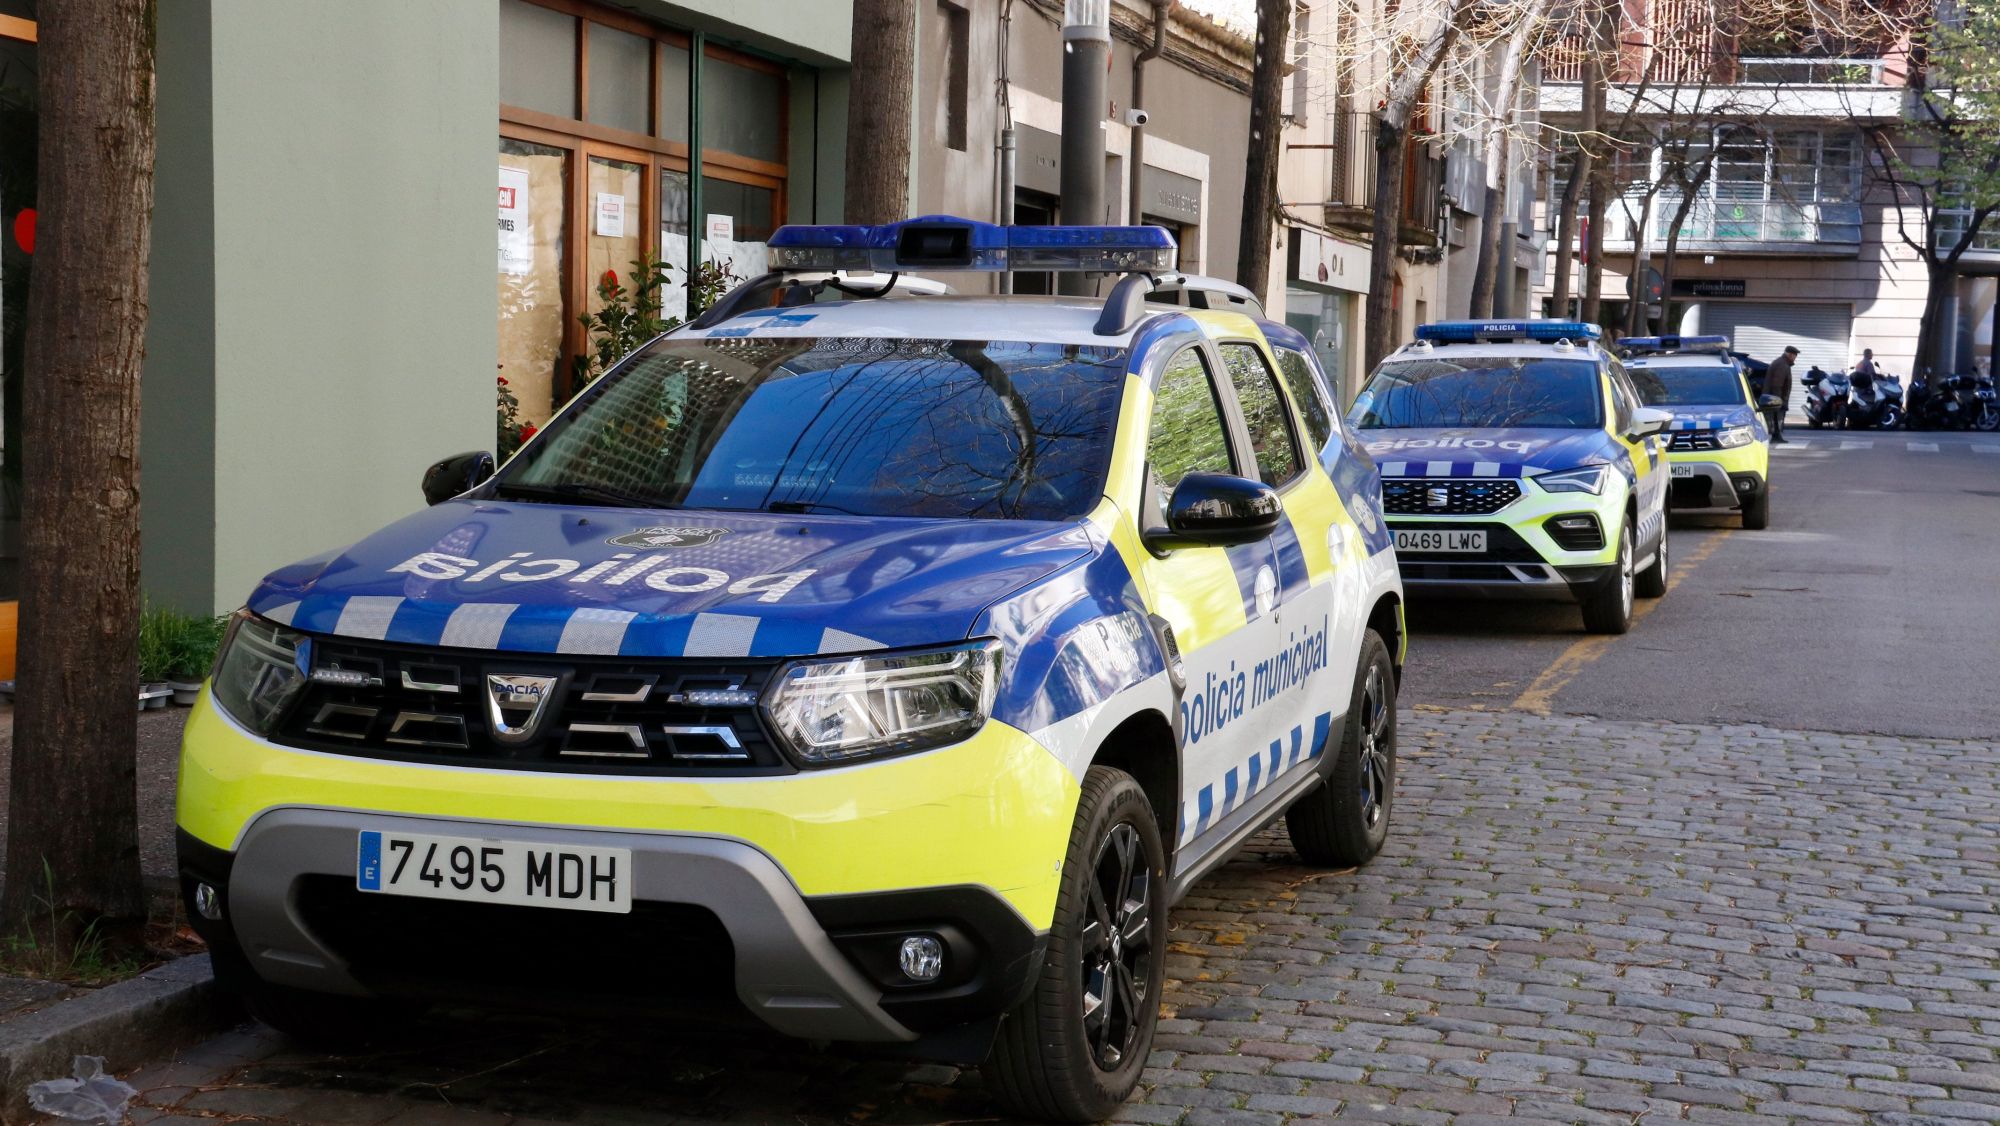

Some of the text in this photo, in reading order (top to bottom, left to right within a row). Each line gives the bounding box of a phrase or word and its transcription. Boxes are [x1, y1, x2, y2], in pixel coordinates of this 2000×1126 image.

[1671, 466, 1691, 475] MDH
[1399, 532, 1482, 550] 0469 LWC
[1252, 614, 1328, 709] municipal
[495, 684, 540, 695] DACIA
[365, 867, 375, 880] E
[390, 839, 616, 902] 7495 MDH
